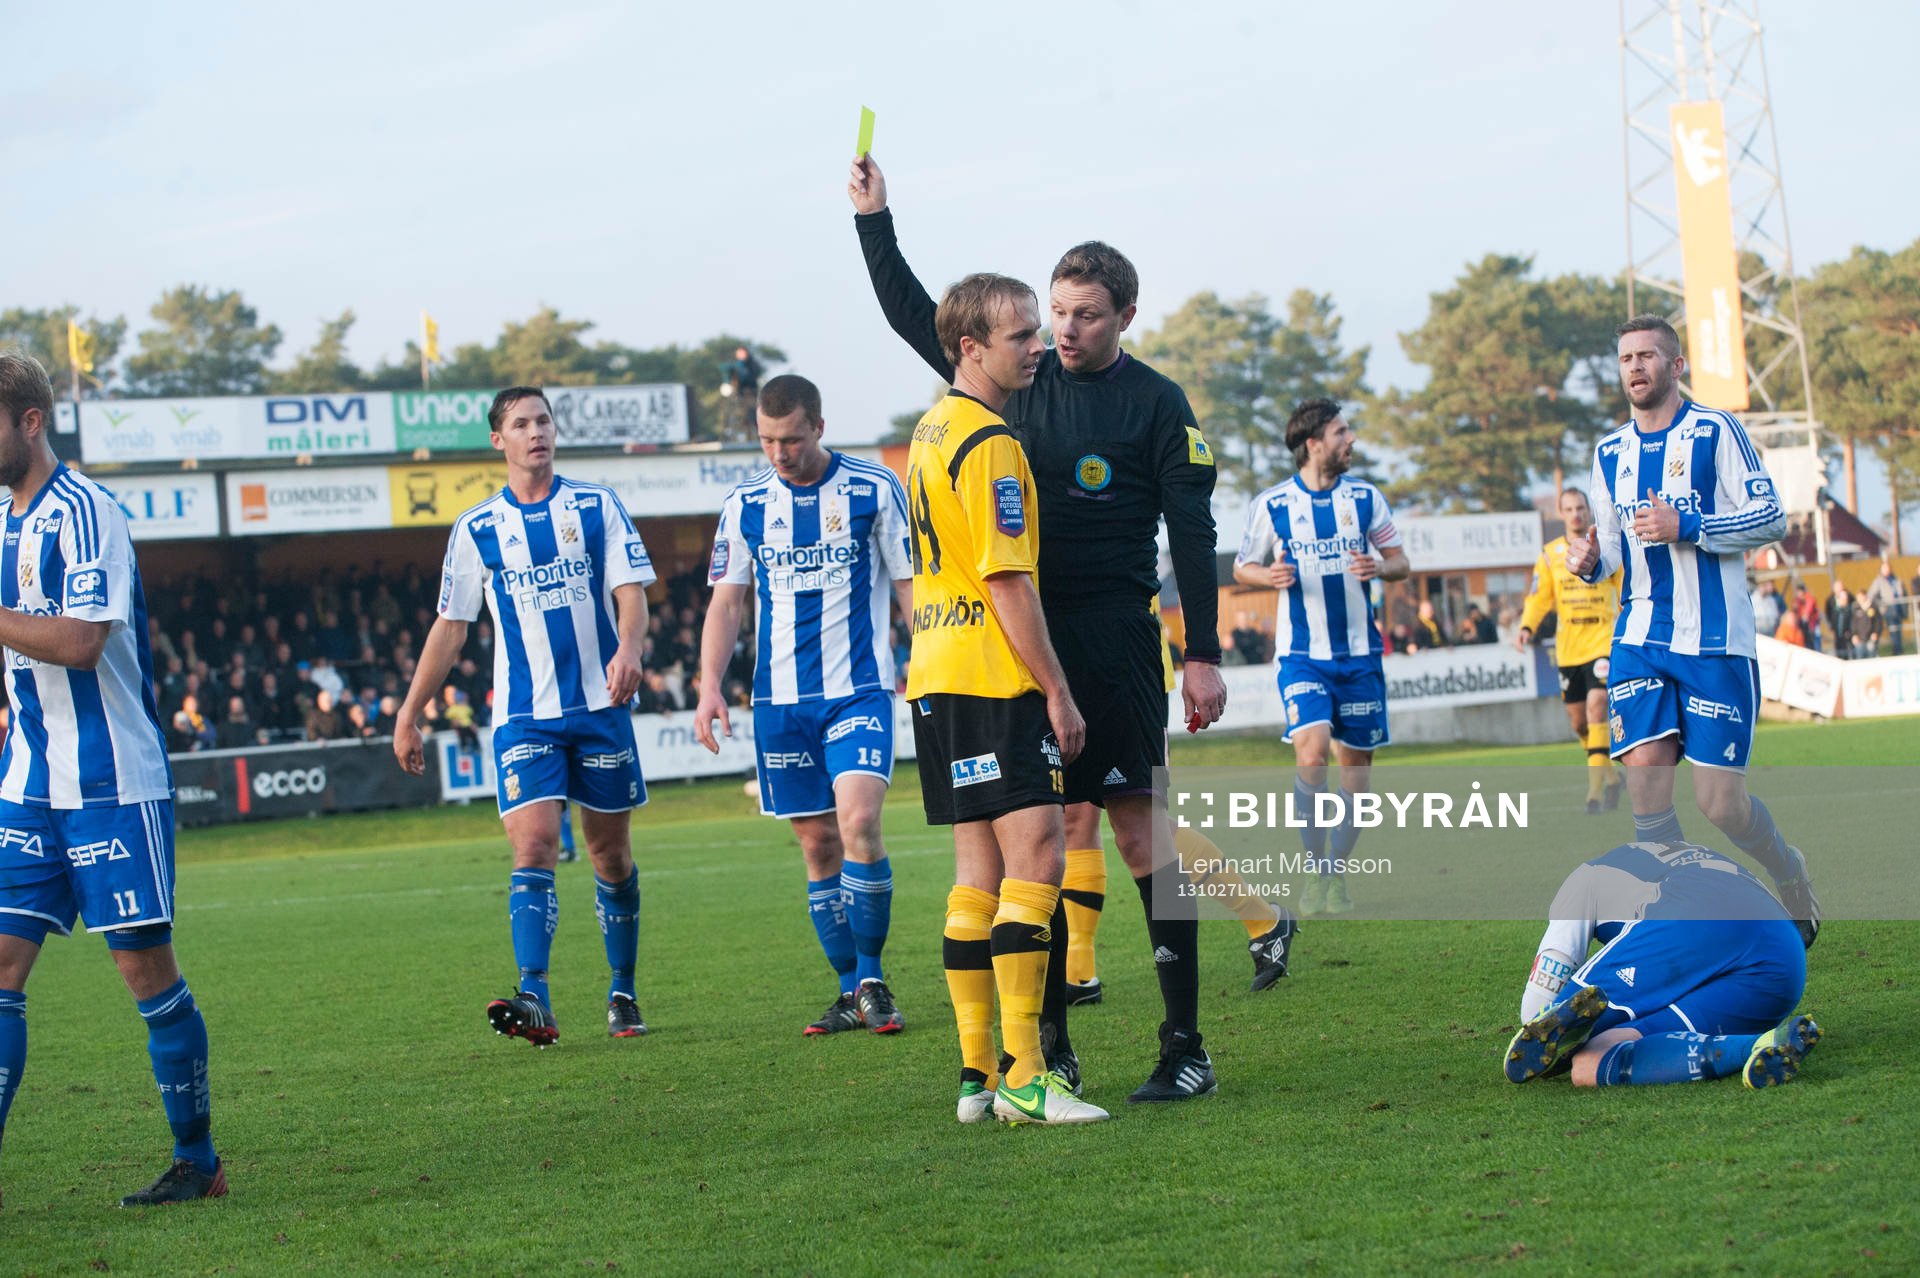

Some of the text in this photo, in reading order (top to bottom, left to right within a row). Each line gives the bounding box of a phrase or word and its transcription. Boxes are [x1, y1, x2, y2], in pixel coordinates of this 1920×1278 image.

[266, 397, 367, 424] DM
[399, 391, 494, 425] union
[267, 426, 370, 451] måleri
[761, 541, 857, 567] Prioritet
[72, 571, 101, 594] GP
[503, 554, 592, 592] Prioritet
[773, 568, 845, 590] Finans
[68, 593, 105, 605] Batteries
[520, 585, 588, 613] Finans
[1386, 661, 1527, 700] anstadsbladet
[1686, 695, 1743, 723] SEFA
[826, 716, 884, 743] SEFA
[763, 751, 815, 769] EFA
[857, 747, 881, 768] 15
[1722, 742, 1736, 761] 4
[253, 768, 326, 798] ecco
[629, 781, 638, 800] 5
[1049, 768, 1064, 795] 19
[67, 838, 131, 867] SEFA
[113, 890, 140, 917] 11
